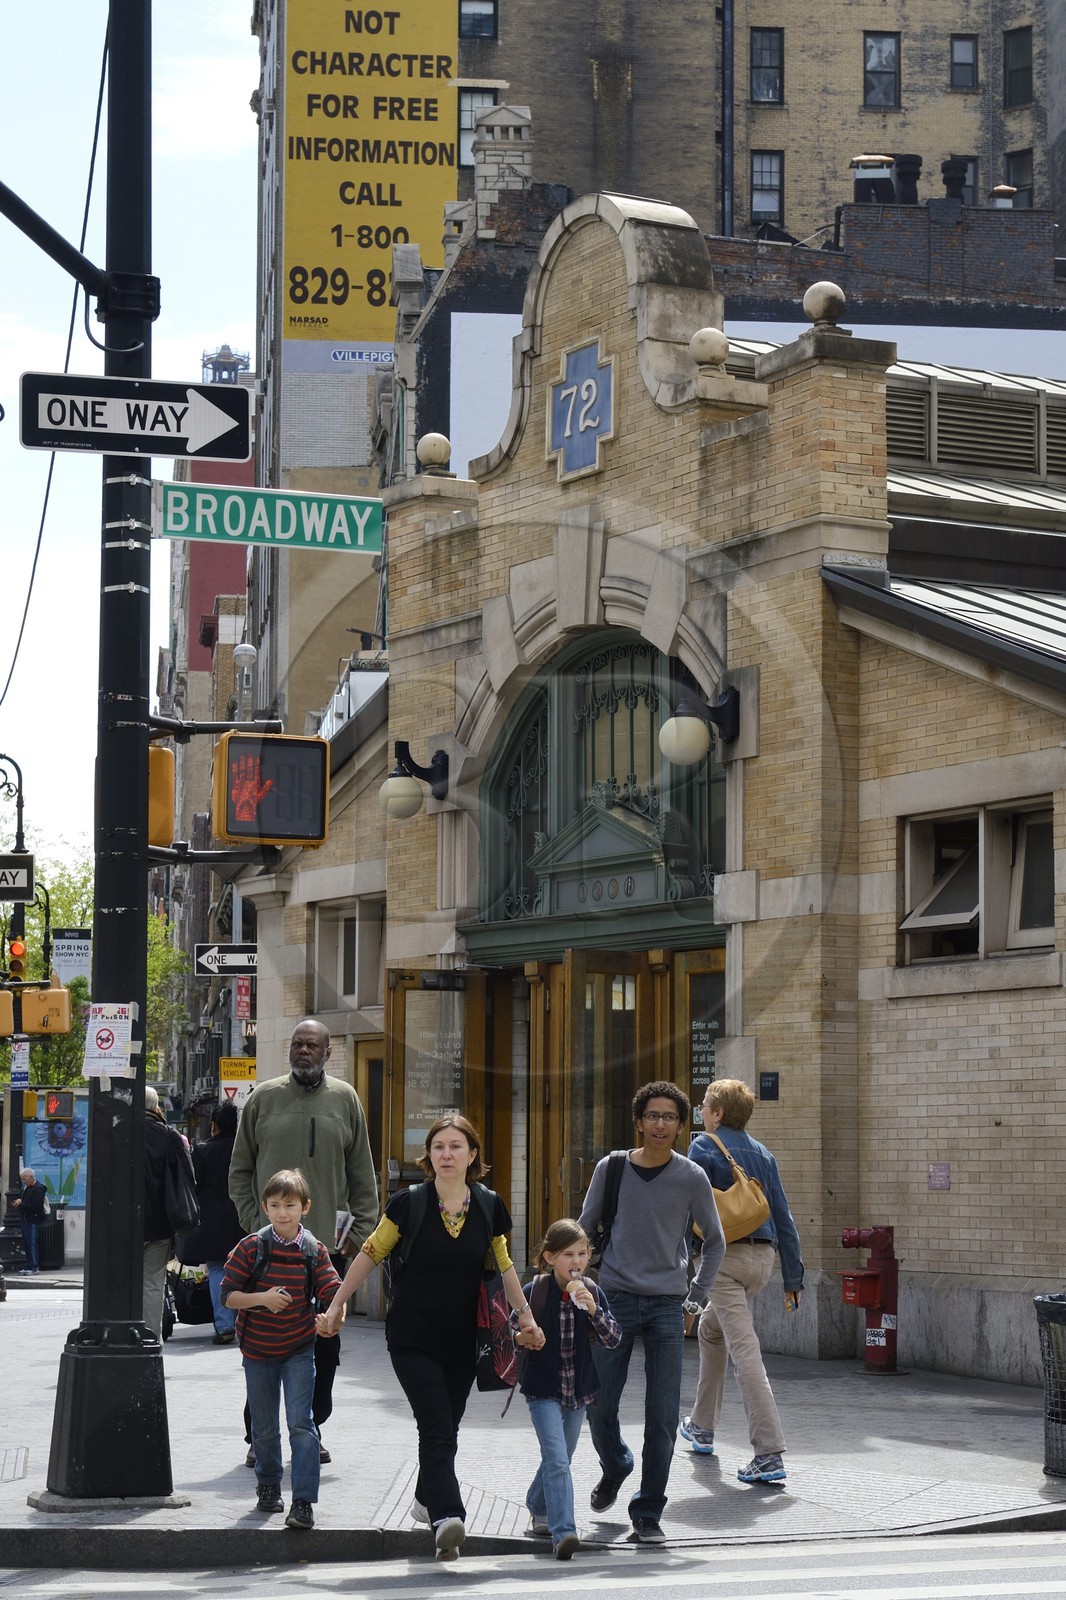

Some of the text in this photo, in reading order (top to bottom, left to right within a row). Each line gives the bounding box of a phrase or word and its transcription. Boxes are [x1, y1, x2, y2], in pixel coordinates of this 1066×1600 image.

[345, 10, 400, 35] NOT
[292, 50, 453, 78] CHARACTER
[307, 94, 438, 122] FOR FREE
[288, 136, 454, 166] INFORMATION
[339, 182, 402, 206] CALL
[331, 224, 410, 248] 1-800
[46, 398, 190, 433] ONE WAY
[560, 377, 600, 438] 72
[166, 490, 372, 546] BROADWAY
[206, 955, 227, 964] ONE
[692, 1021, 706, 1029] Enter
[700, 1032, 709, 1040] buy
